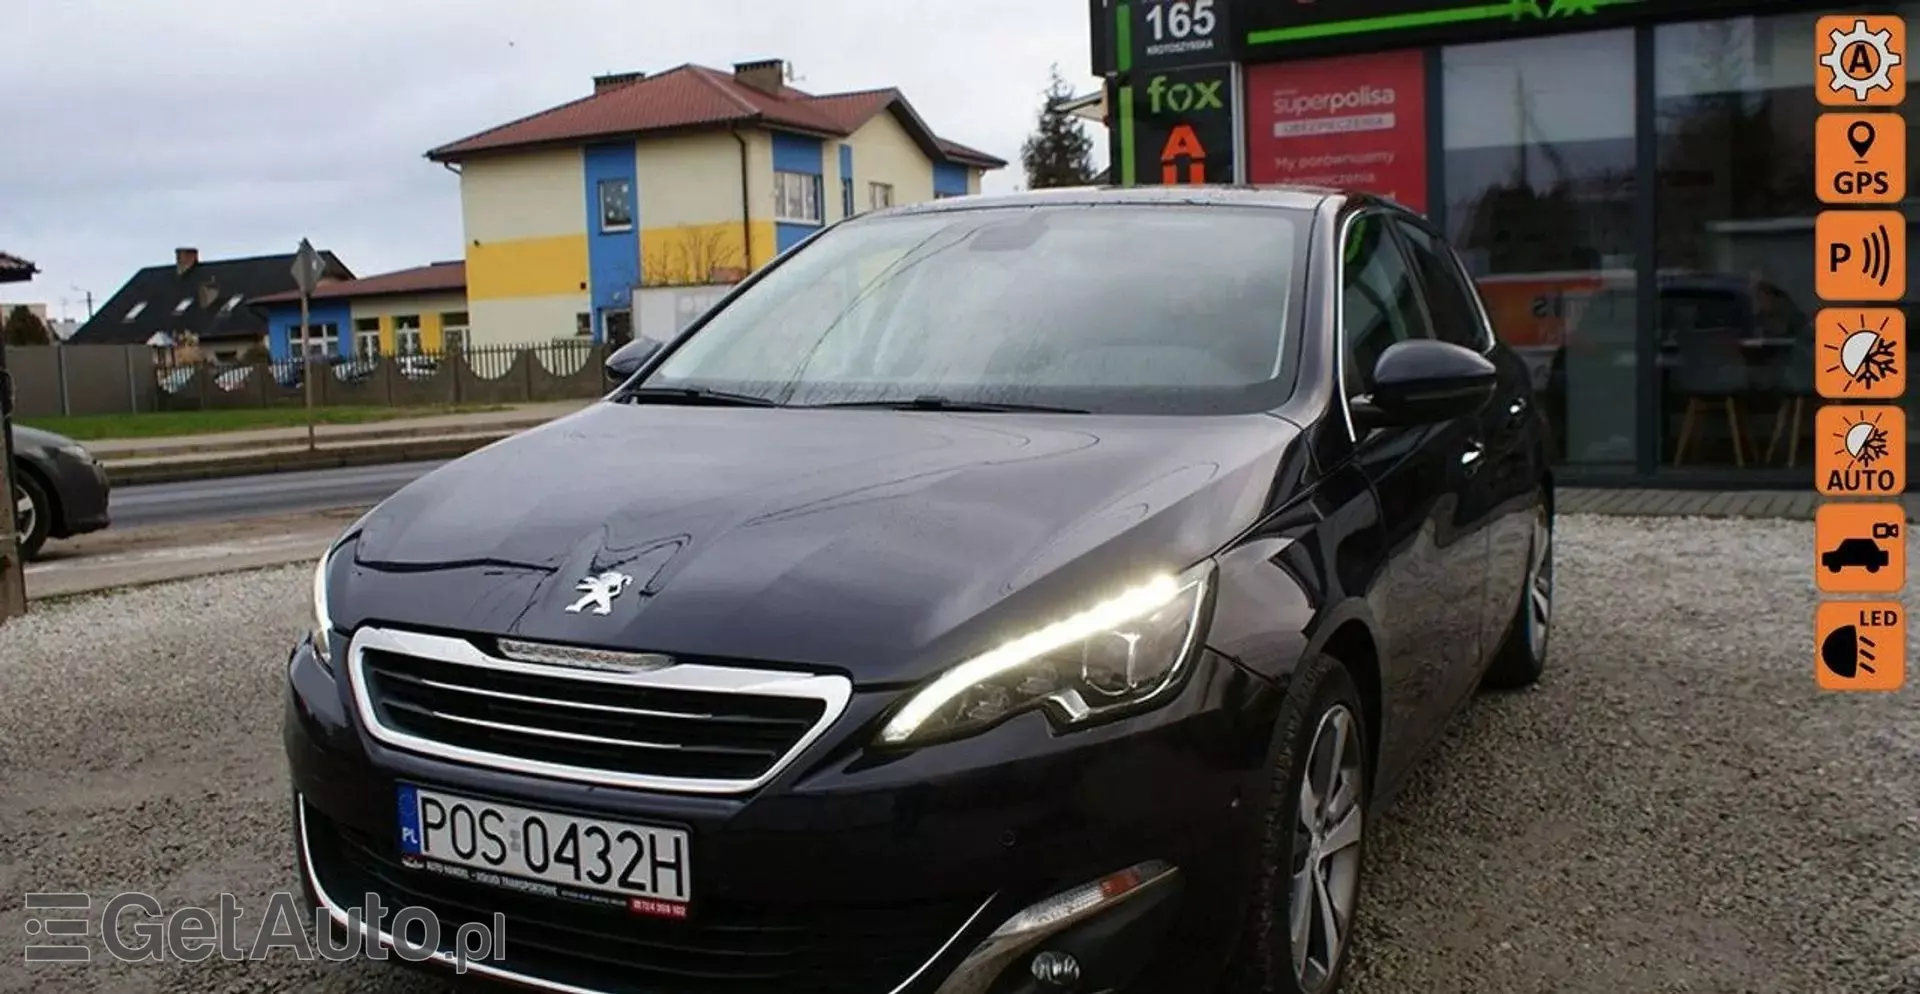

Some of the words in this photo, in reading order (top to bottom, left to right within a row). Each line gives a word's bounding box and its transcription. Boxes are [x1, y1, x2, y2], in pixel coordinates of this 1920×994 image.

[1146, 0, 1216, 40] 165
[1147, 75, 1224, 114] fox
[1273, 86, 1395, 116] superpolisa
[402, 826, 418, 845] PL
[420, 796, 507, 866] POS
[522, 815, 684, 897] 0432H
